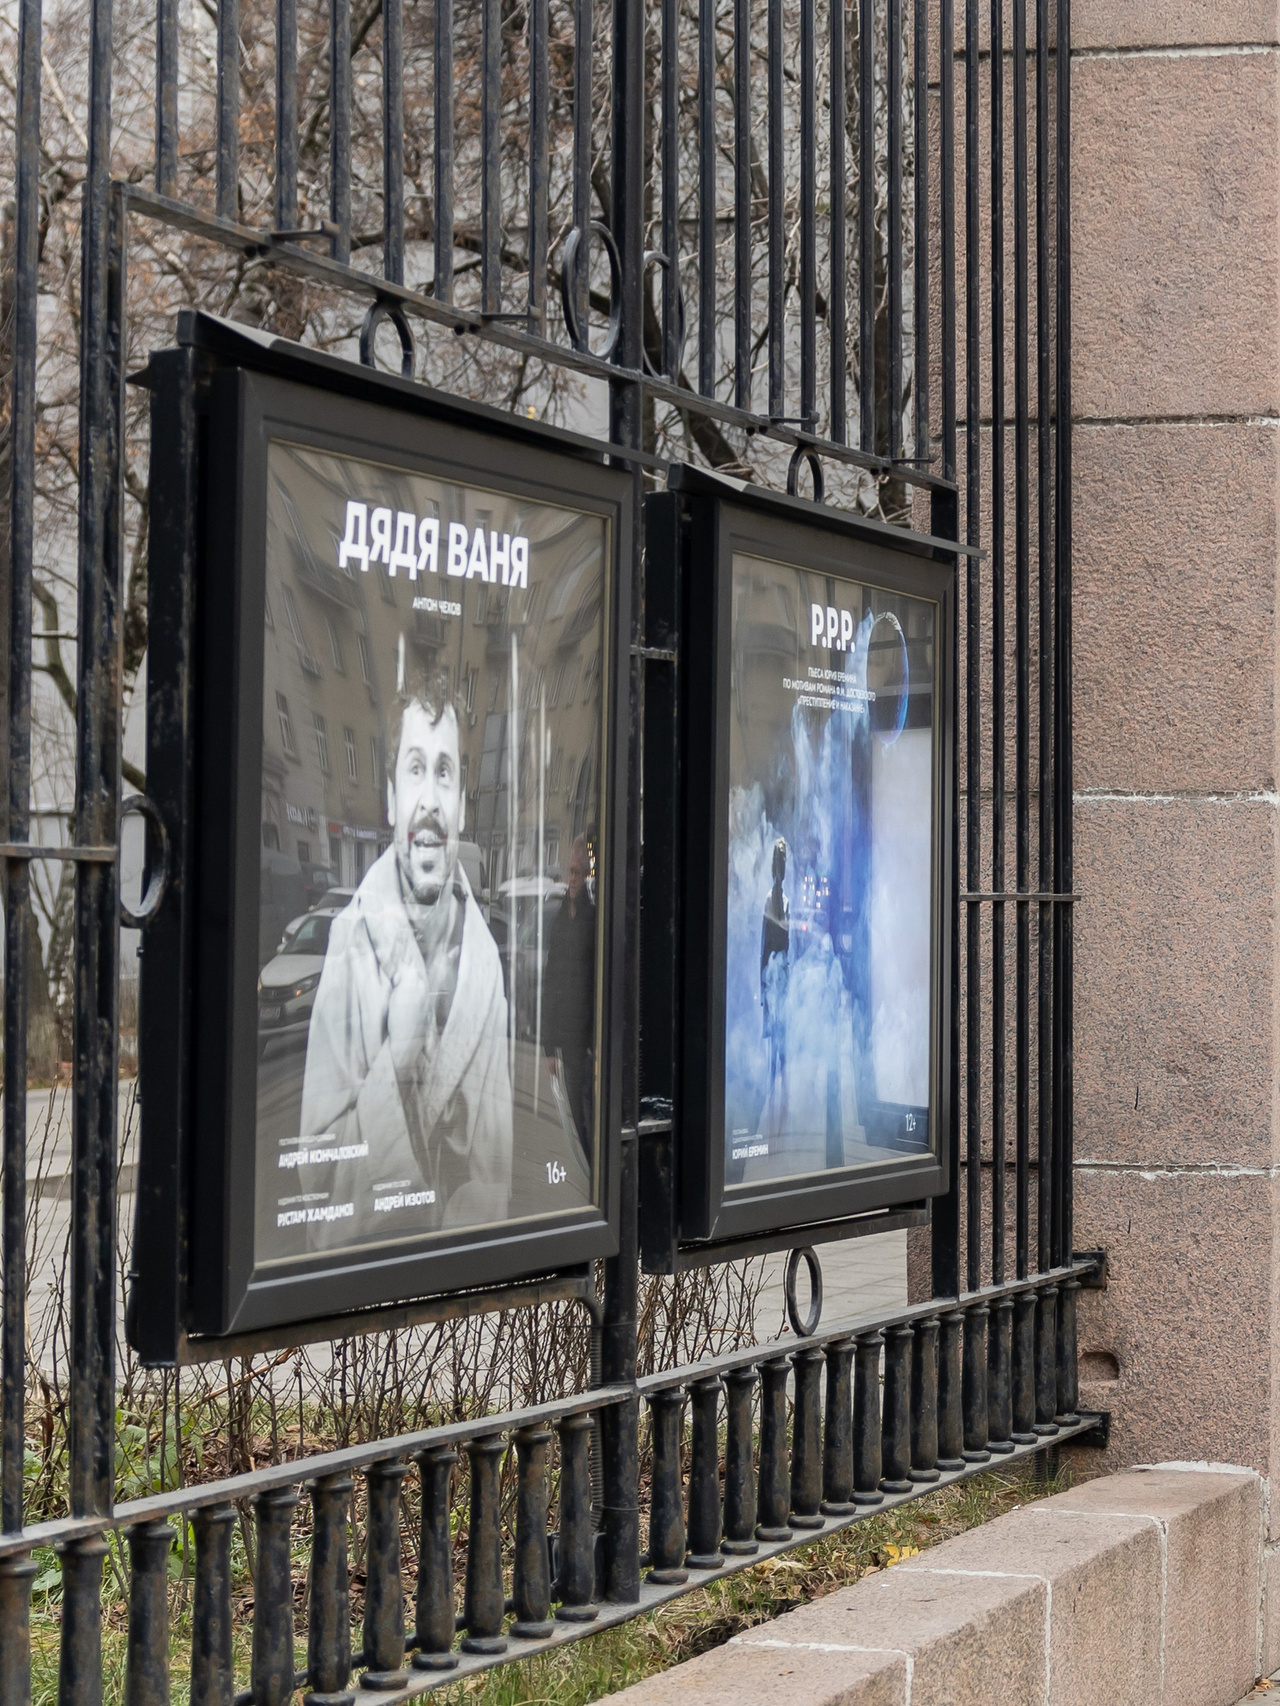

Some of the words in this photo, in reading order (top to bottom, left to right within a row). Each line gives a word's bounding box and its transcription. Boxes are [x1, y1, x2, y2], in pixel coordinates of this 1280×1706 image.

[339, 500, 440, 581] ДЯДЯ
[446, 522, 530, 589] ВАНЯ
[412, 596, 438, 611] АНТОН
[438, 600, 462, 616] ЧЕХОВ
[808, 666, 824, 679] ПЬЕСА
[824, 669, 837, 681] ЮРИЯ
[782, 678, 791, 689] ПО
[791, 680, 817, 693] МОТИВАМ
[816, 683, 836, 695] РОМАНА
[279, 1147, 309, 1169] АНДРЕЙ
[546, 1161, 567, 1185] 16+
[374, 1191, 404, 1212] АНДРЕЙ
[404, 1190, 436, 1207] ИЗОТОВ
[277, 1209, 306, 1228] РУСТАМ
